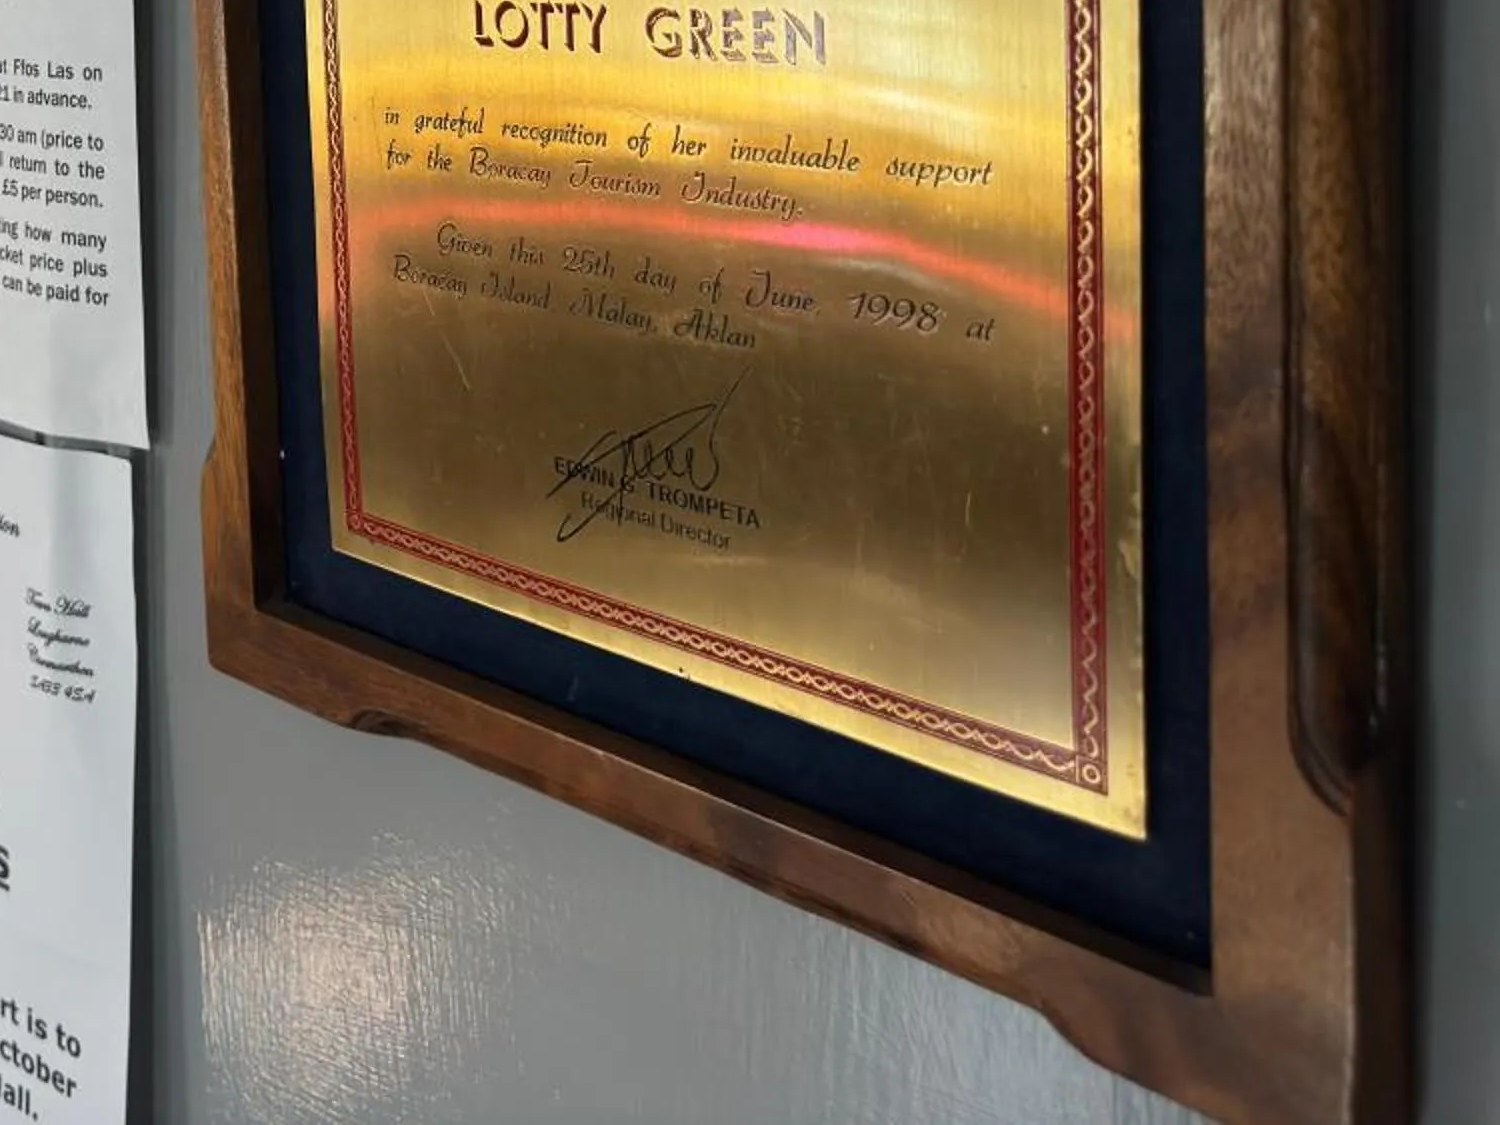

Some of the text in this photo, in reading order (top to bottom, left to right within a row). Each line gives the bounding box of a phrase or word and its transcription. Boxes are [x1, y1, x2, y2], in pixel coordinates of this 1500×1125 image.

[643, 6, 827, 67] GREEN
[13, 58, 40, 77] Ffos
[47, 60, 75, 80] Las
[83, 65, 103, 82] on
[13, 85, 25, 103] in
[27, 88, 92, 109] advance.
[17, 128, 37, 145] am
[41, 128, 83, 150] (price
[88, 133, 104, 152] to
[384, 106, 994, 189] in grateful recognition of her invaluable support
[9, 154, 47, 174] return
[54, 158, 70, 176] to
[78, 160, 105, 180] the
[386, 138, 804, 221] for the Boracay Tourism Industry.
[2, 179, 18, 197] £5
[21, 184, 42, 202] per
[45, 188, 103, 208] person.
[24, 222, 51, 243] how
[61, 230, 107, 253] many
[30, 252, 64, 273] price
[73, 259, 108, 278] plus
[436, 220, 494, 257] Given
[509, 235, 545, 267] this
[562, 244, 616, 279] 25th
[633, 256, 678, 295] day
[699, 266, 725, 305] of
[850, 290, 941, 334] 1998
[965, 317, 996, 342] at
[2, 274, 23, 292] can
[26, 278, 43, 297] be
[46, 283, 80, 303] paid
[85, 286, 109, 306] for
[392, 252, 468, 301] Boracay
[671, 307, 757, 350] Aklan
[580, 489, 733, 552] Regional Director
[646, 479, 762, 531] TROMPETA
[26, 1006, 48, 1040] is
[56, 1023, 81, 1058] to
